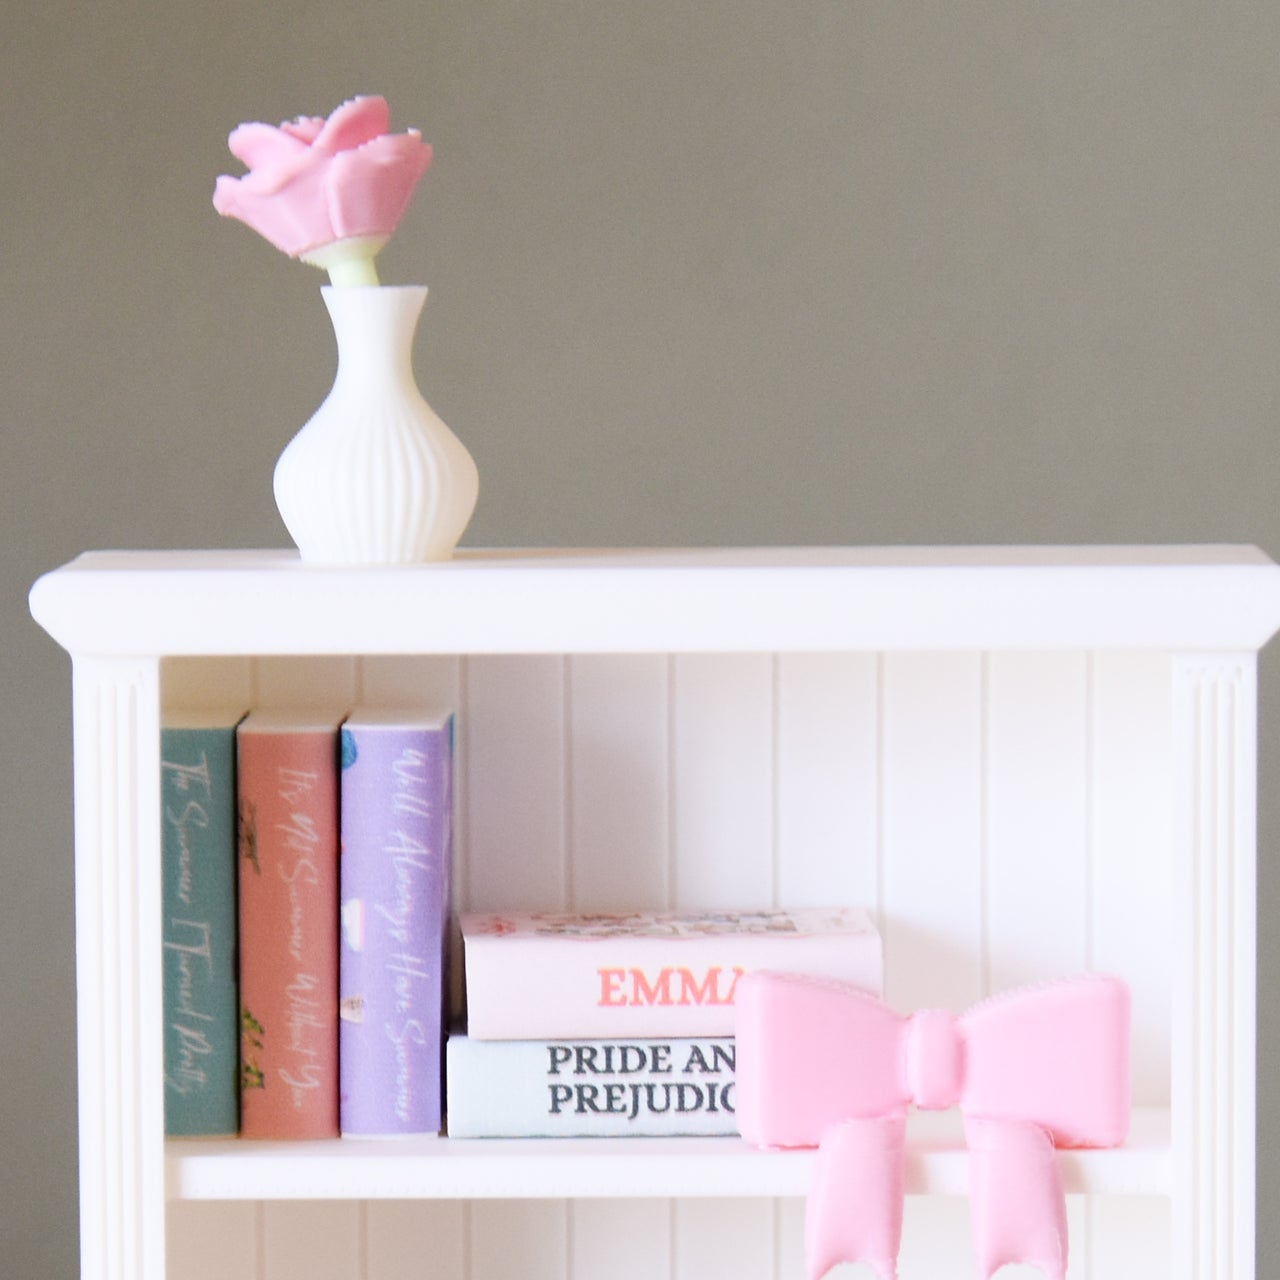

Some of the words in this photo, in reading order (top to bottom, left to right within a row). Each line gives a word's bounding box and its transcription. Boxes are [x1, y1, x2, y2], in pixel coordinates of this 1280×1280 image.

[375, 828, 431, 943] Always
[386, 953, 429, 1014] Have
[385, 1019, 427, 1121] Summer
[547, 1044, 672, 1076] PRIDE
[682, 1044, 735, 1074] AN
[547, 1082, 735, 1120] PREJUDIC
